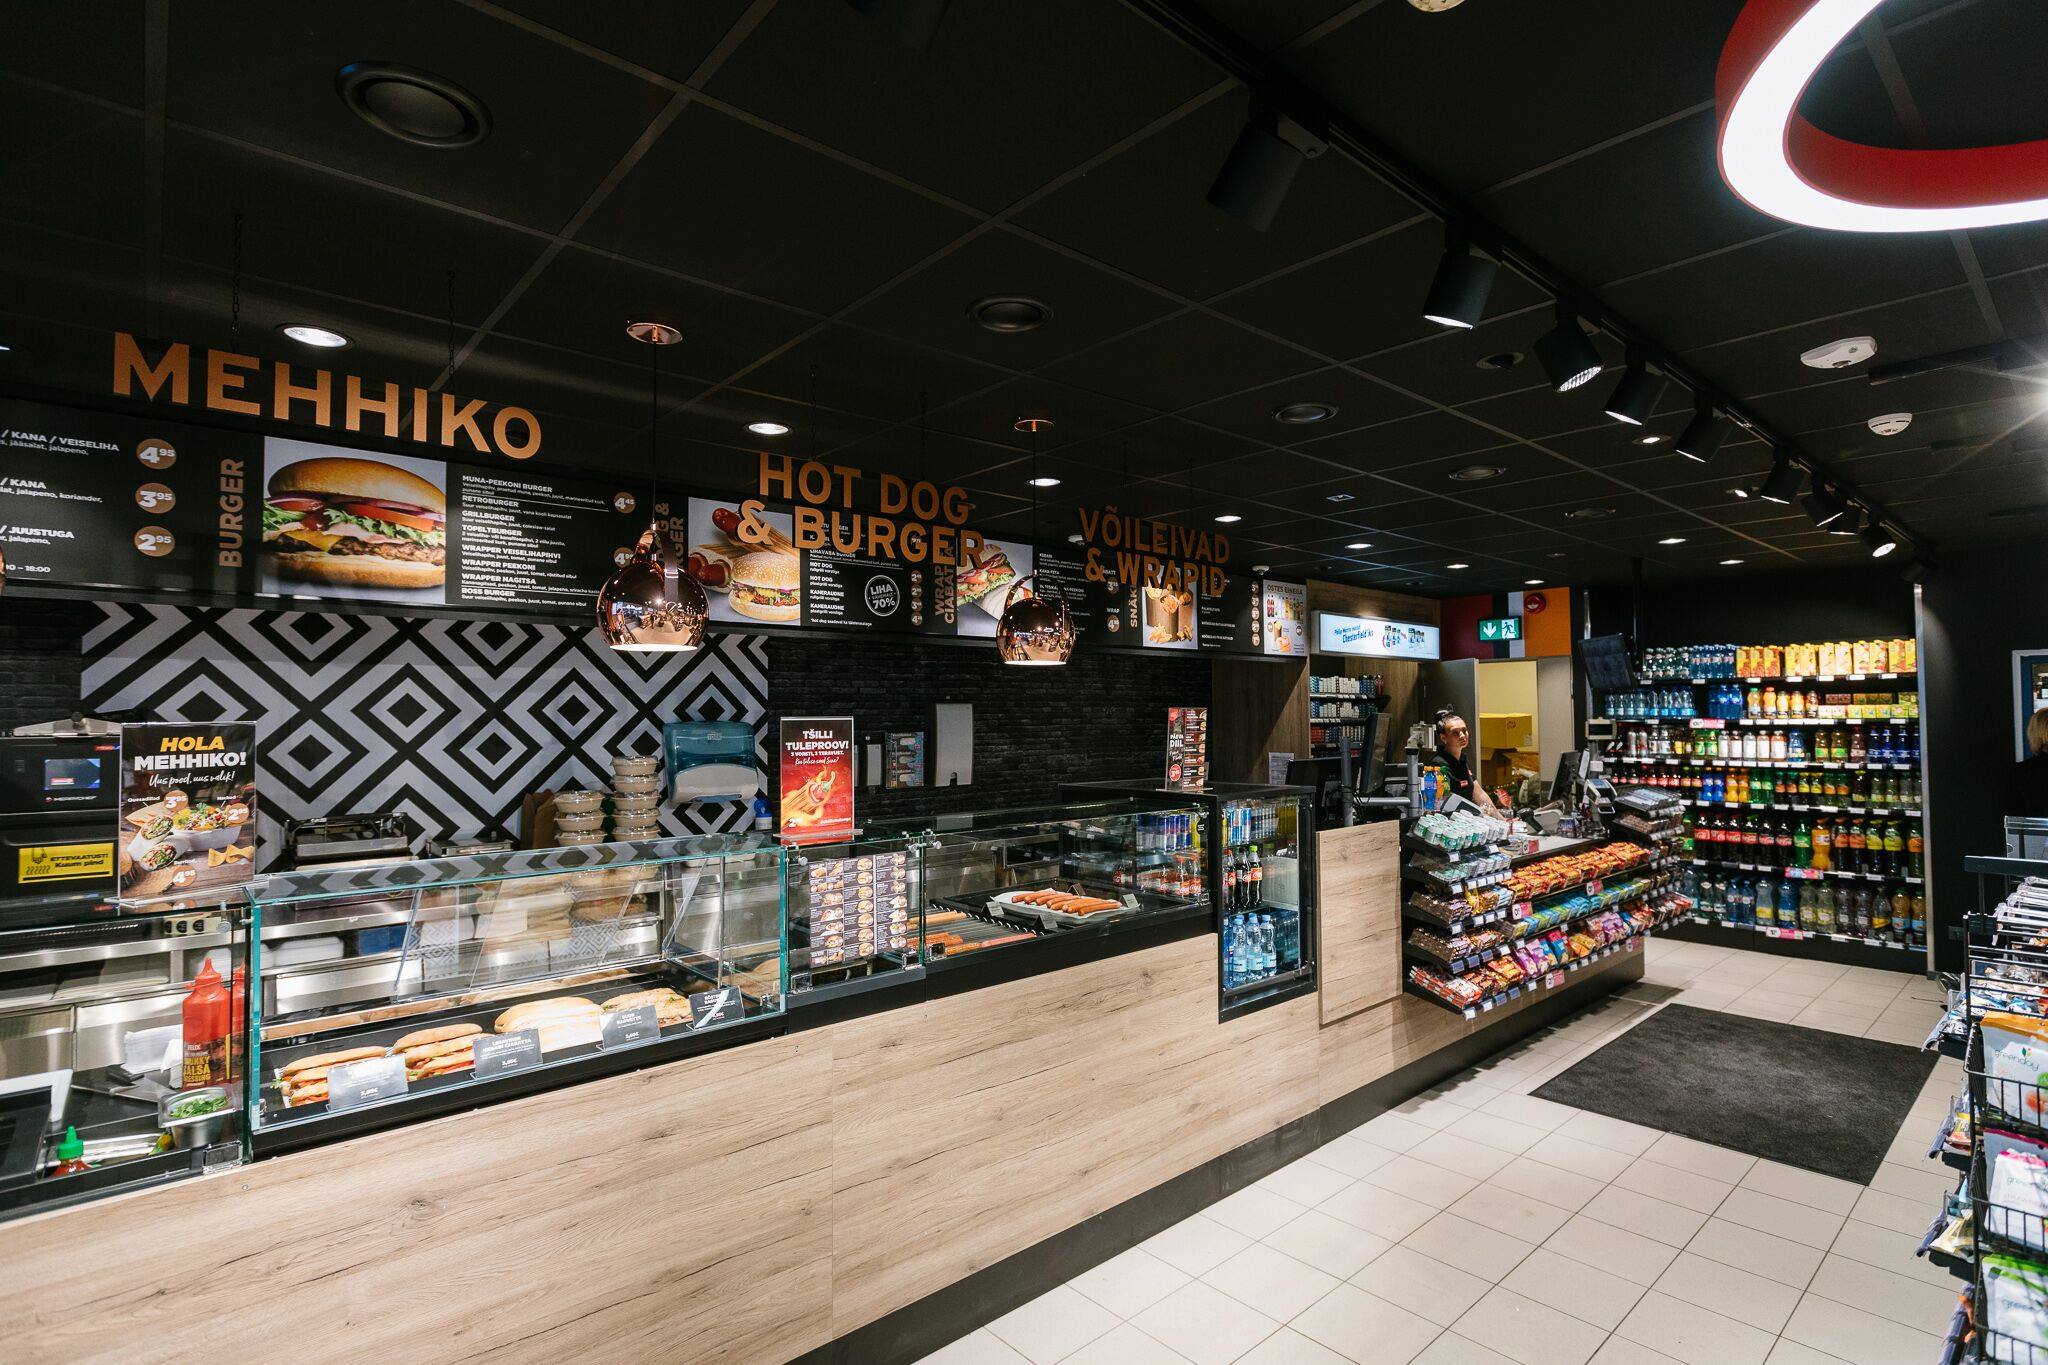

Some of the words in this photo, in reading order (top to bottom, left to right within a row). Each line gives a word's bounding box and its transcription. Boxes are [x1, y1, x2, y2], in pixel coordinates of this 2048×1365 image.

[113, 331, 542, 459] MEHHIKO
[11, 431, 48, 442] KANA
[58, 437, 120, 452] VEISELIHA
[9, 479, 47, 489] KANA
[462, 475, 522, 488] MUNA-PEEKONI
[522, 483, 553, 492] BURGER
[760, 451, 862, 509] HOT
[880, 472, 972, 526] DOG
[462, 495, 519, 507] RETROBURGER
[219, 458, 244, 568] BURGER
[462, 510, 515, 521] GRILLBURGER
[8, 526, 75, 539] JUUSTUGA
[462, 524, 523, 536] TOPELTBURGER
[737, 499, 773, 547] &
[794, 505, 985, 568] BURGER
[1078, 505, 1231, 563] VÕILEIVAD
[462, 544, 502, 553] WRAPPER
[502, 547, 561, 559] VEISELIHAPIHVI
[25, 565, 51, 573] 18:00
[462, 558, 502, 568] WRAPPER
[502, 561, 536, 571] PEEKONI
[462, 572, 502, 582] WRAPPER
[502, 576, 537, 585] NAGITSA
[1085, 548, 1107, 582] &
[1117, 551, 1226, 597] WRAPID
[461, 587, 483, 595] BOSS
[483, 589, 516, 597] BURGER
[870, 584, 893, 596] LIHA
[934, 565, 945, 616] WRAP
[872, 597, 896, 610] 70%
[803, 728, 833, 740] TŠILLI
[160, 736, 225, 753] HOLA
[785, 741, 849, 751] TULEPROOV!
[1169, 740, 1184, 748] DIIL
[134, 752, 247, 771] MEHHIKO!
[50, 852, 109, 862] ETTEVAATUST!
[55, 860, 82, 868] Kuum
[84, 859, 104, 867] pind
